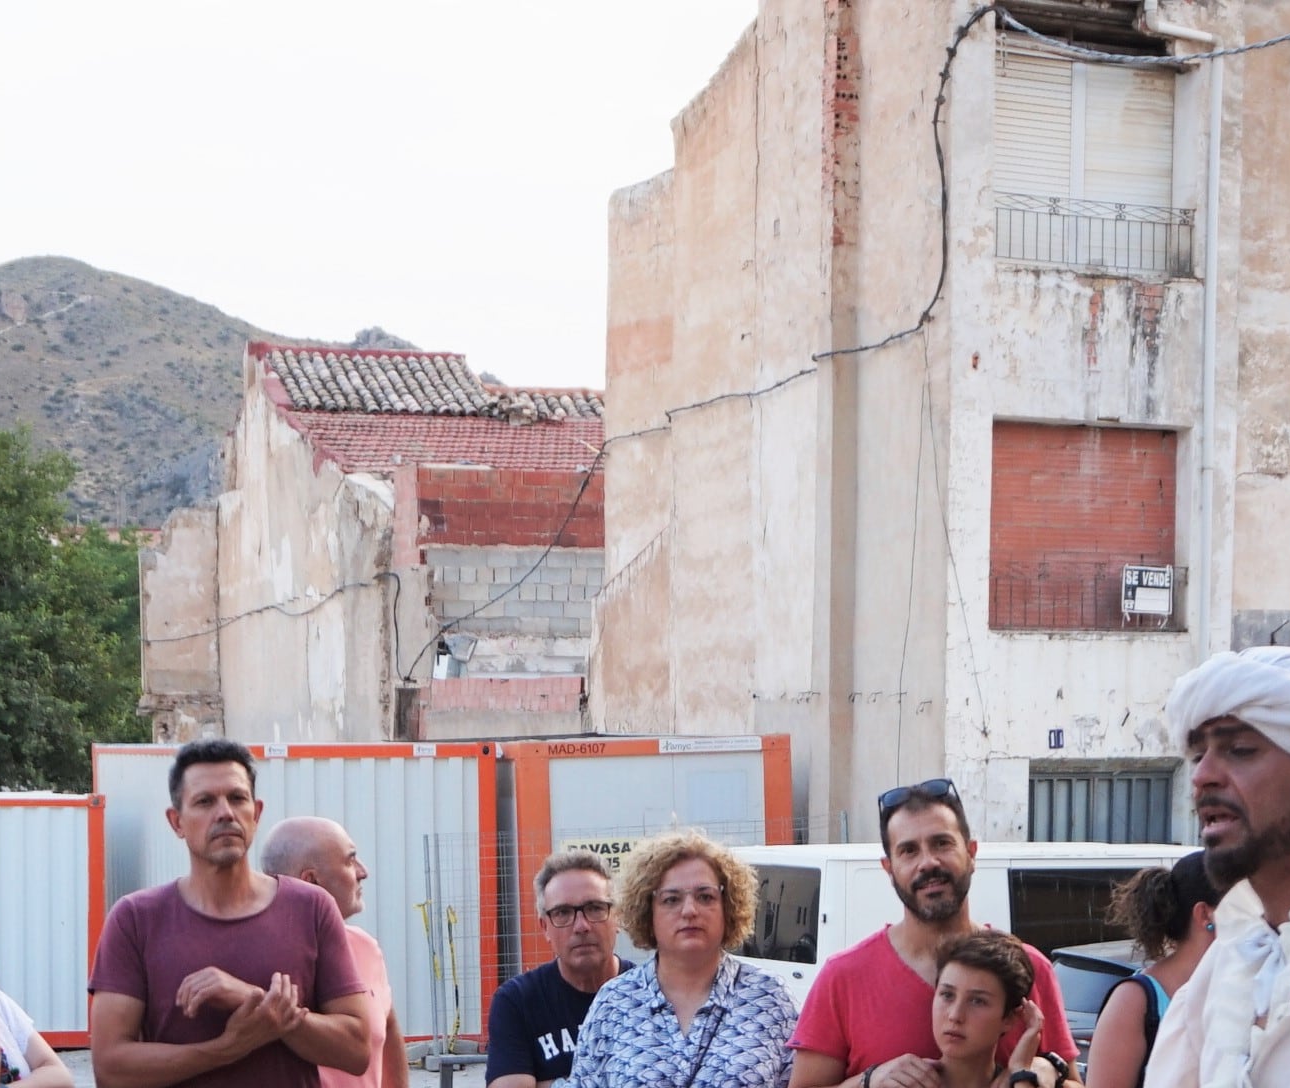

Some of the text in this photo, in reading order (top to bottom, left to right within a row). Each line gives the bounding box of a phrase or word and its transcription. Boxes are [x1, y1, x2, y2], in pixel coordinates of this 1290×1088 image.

[1126, 570, 1170, 587] SE VENDE
[548, 743, 606, 755] MAD-6107
